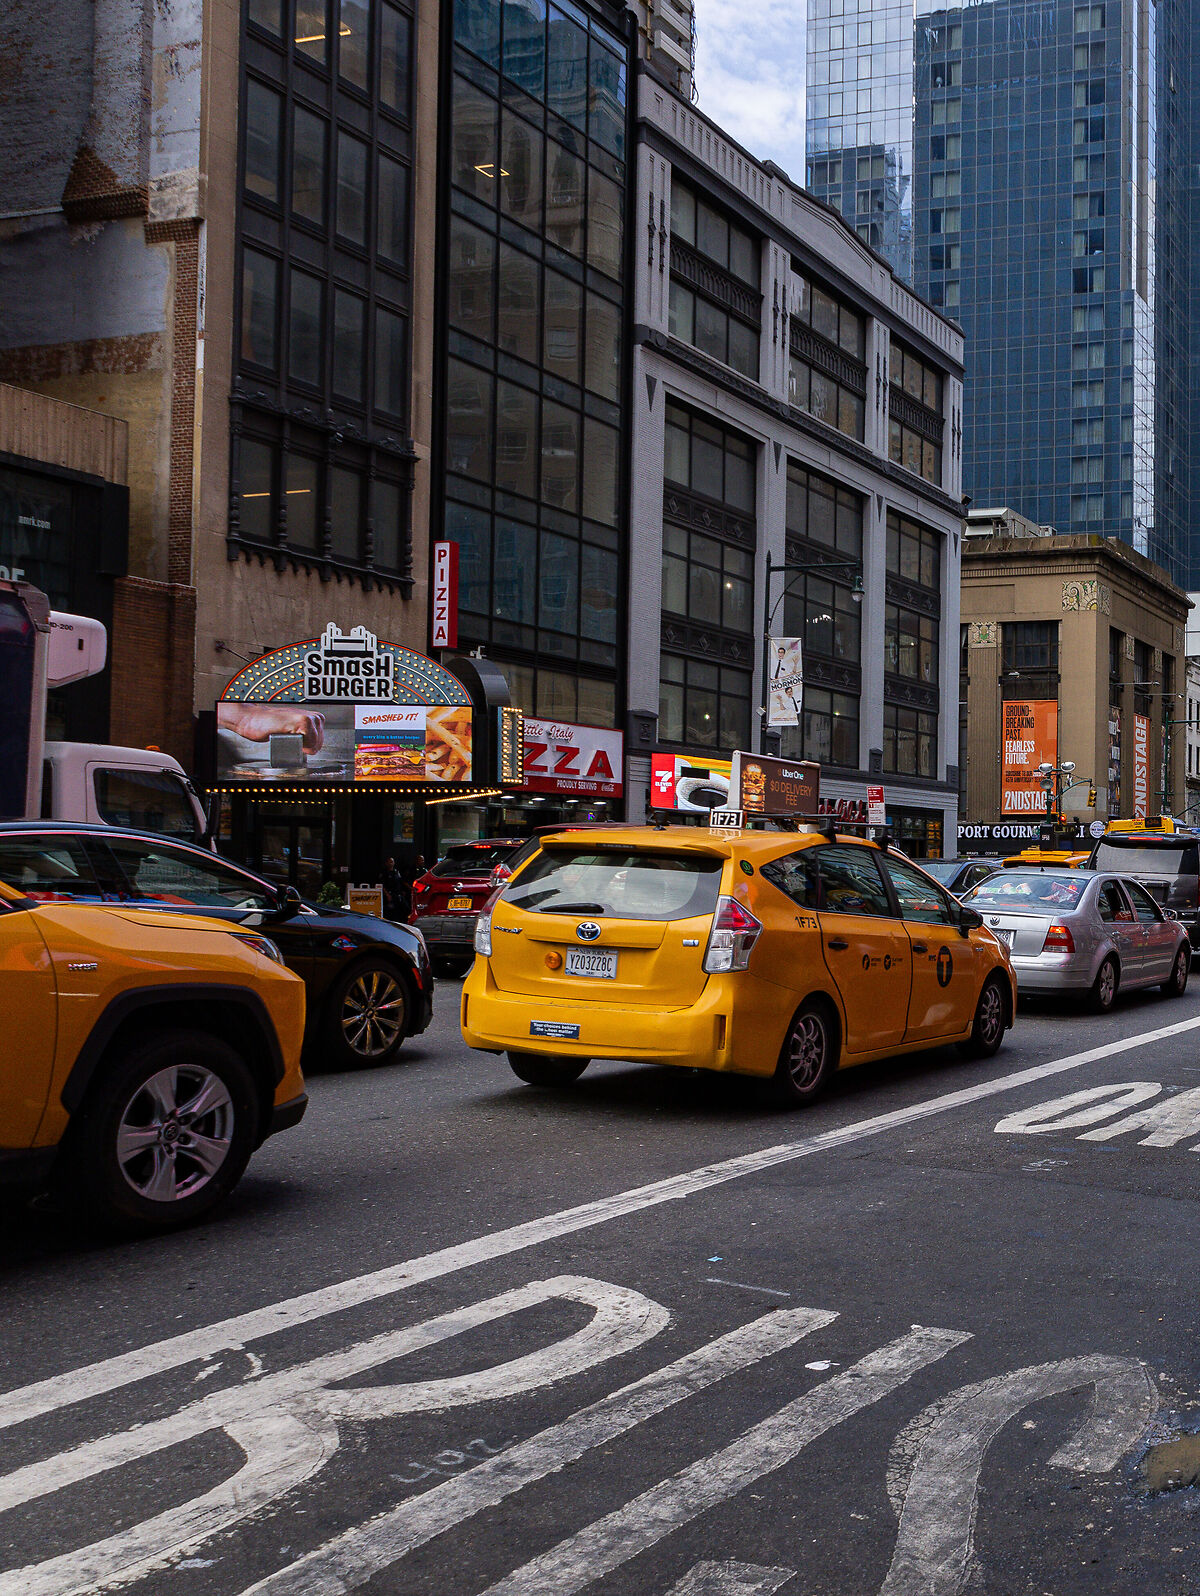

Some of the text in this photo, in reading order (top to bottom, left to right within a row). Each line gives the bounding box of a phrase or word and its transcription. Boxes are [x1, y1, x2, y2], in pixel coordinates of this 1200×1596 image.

[435, 549, 448, 640] PIZZA
[308, 677, 390, 697] BURGER
[771, 676, 803, 691] MORMON
[1005, 705, 1032, 717] GROUND-
[362, 712, 419, 725] SMASHED IT!
[1005, 717, 1035, 729] BREAKING
[550, 724, 574, 741] Italy
[1005, 729, 1022, 741] PAST.
[1005, 740, 1035, 753] FEARLESS
[523, 742, 615, 778] ZZA
[1005, 752, 1029, 765] FUTURE.
[1135, 715, 1147, 818] 2NDSTAGE
[556, 779, 598, 791] PROUDLY SERVING
[770, 780, 812, 797] $0 DELIVERY
[785, 793, 798, 806] FEE
[1004, 790, 1053, 811] 2NDSTAG
[712, 812, 737, 826] 1F73
[957, 825, 988, 838] PORT
[795, 916, 817, 929] 1F73
[940, 954, 950, 983] T
